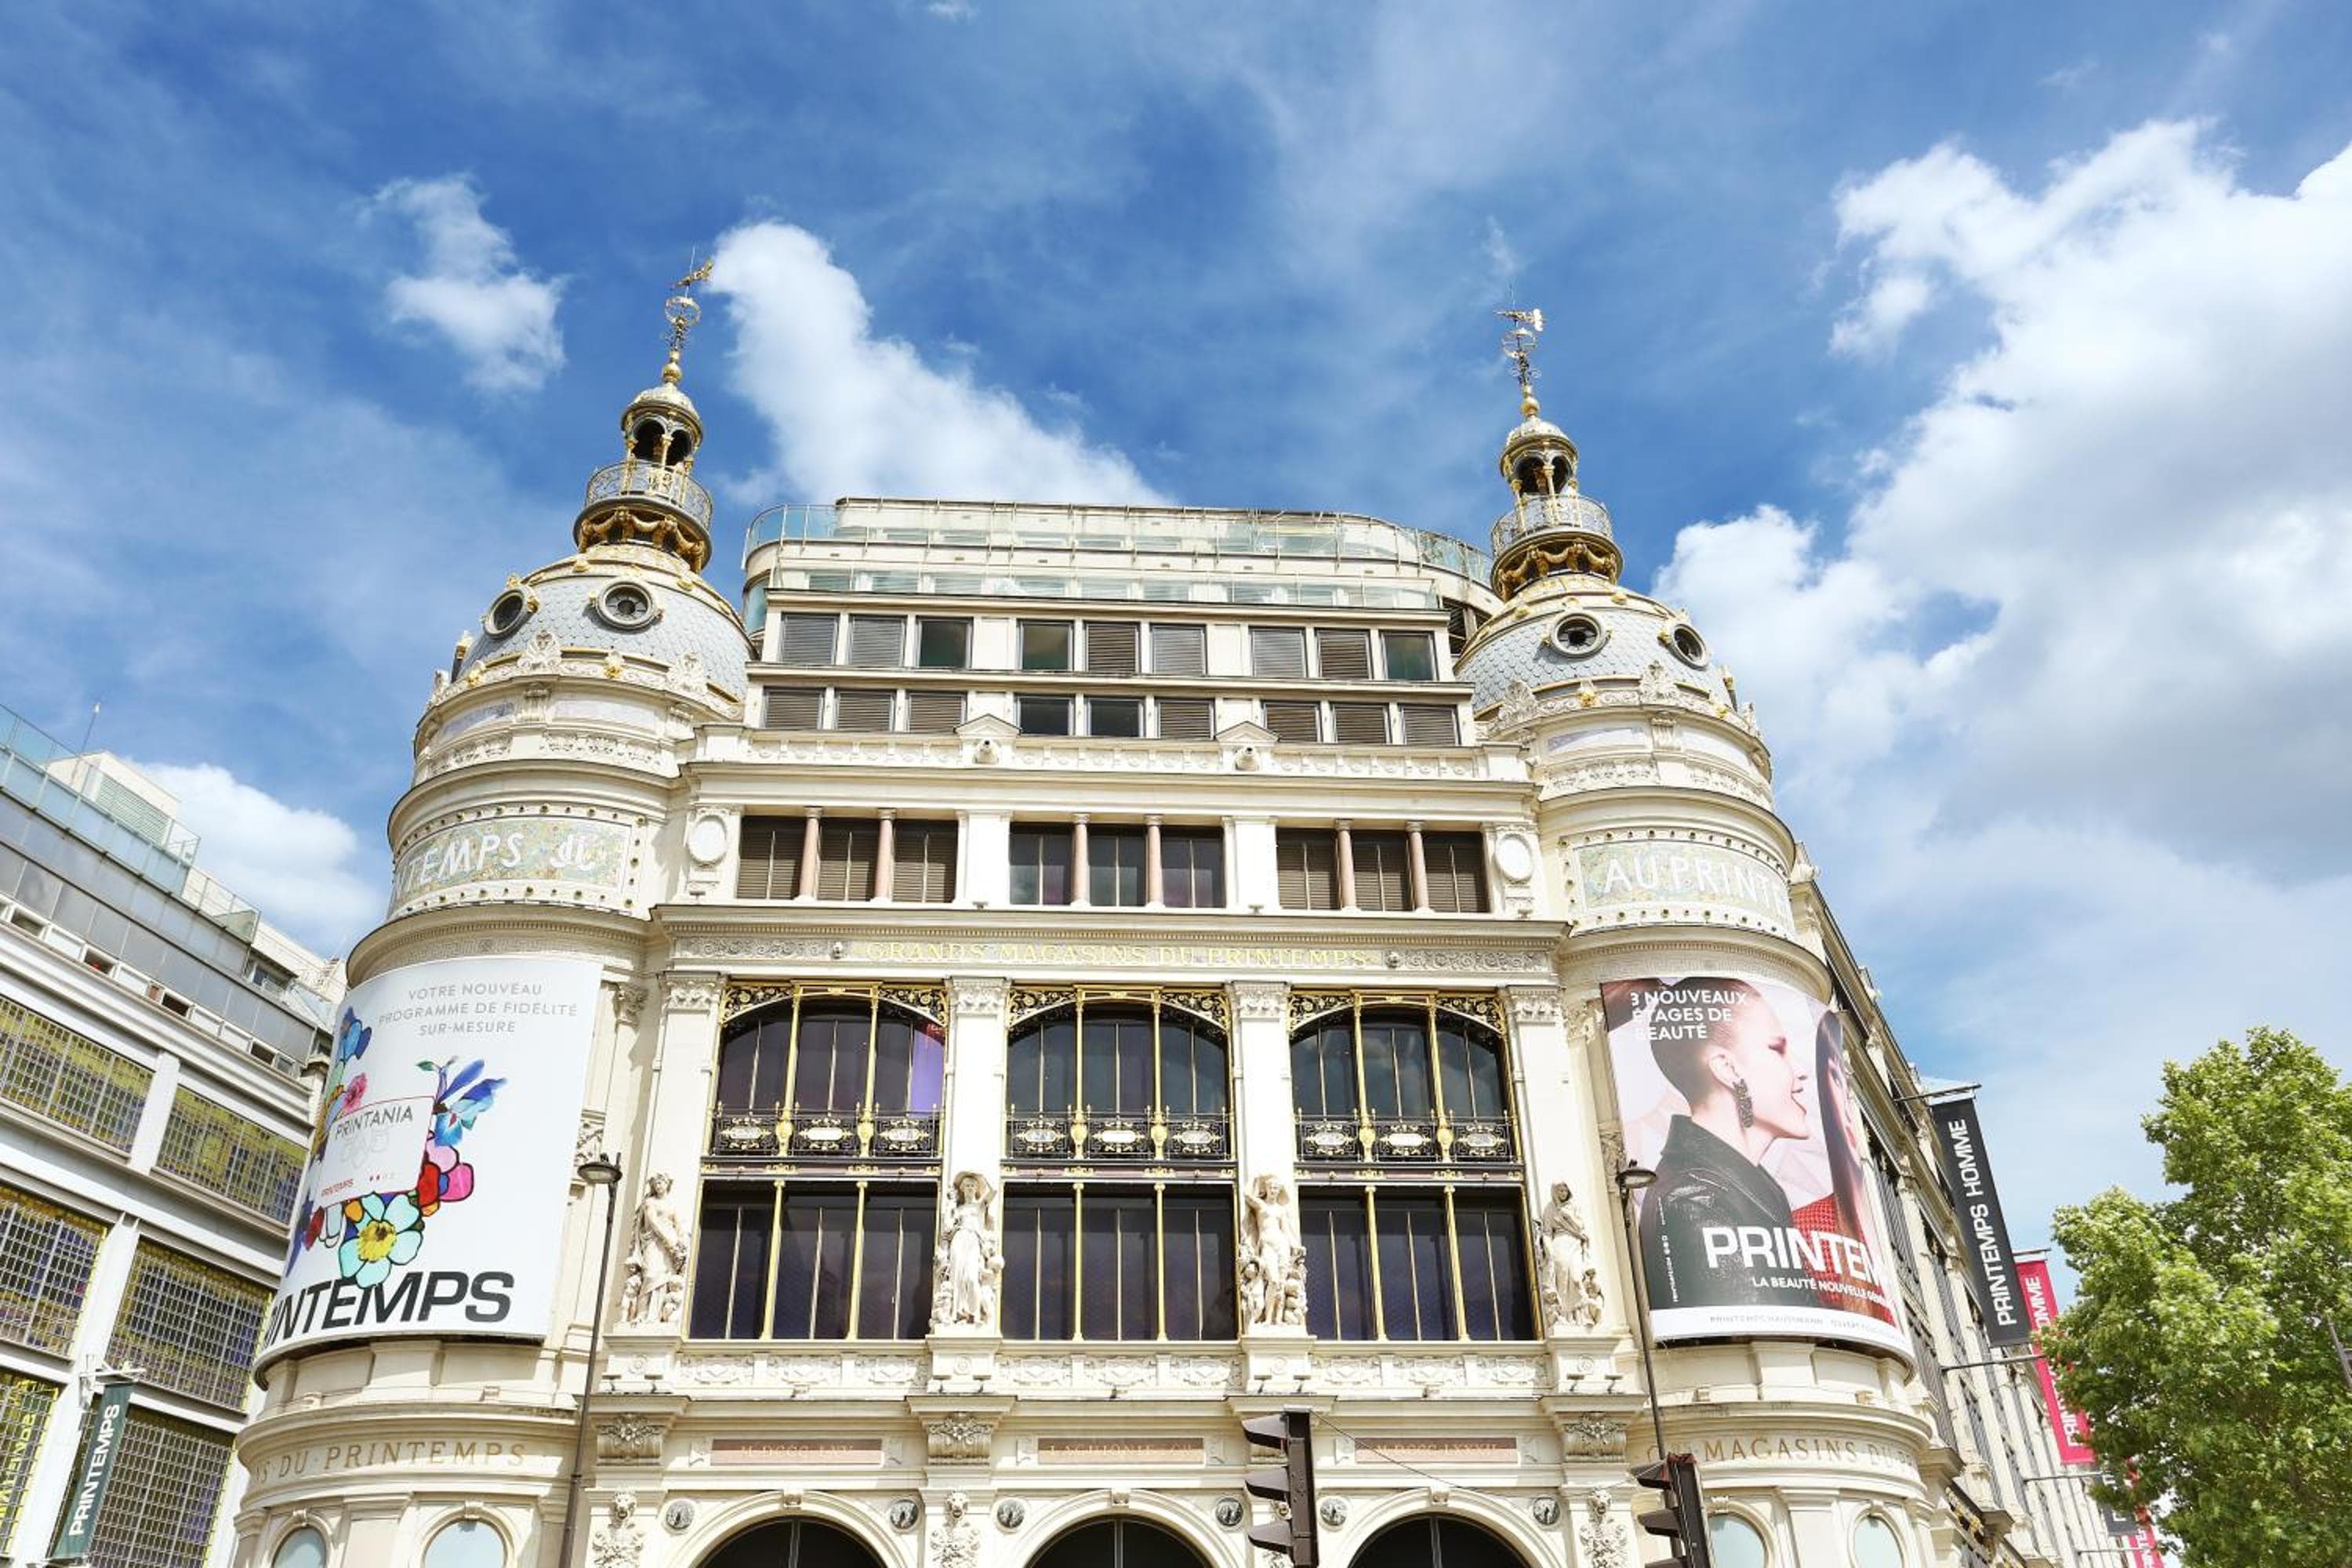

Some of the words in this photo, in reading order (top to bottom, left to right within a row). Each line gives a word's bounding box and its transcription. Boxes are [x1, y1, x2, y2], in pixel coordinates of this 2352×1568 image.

[1605, 854, 1657, 892] AU
[866, 942, 985, 959] GRANDS
[1160, 948, 1194, 964] DU
[1208, 949, 1367, 968] PRINTEMPS
[408, 985, 456, 1000] VOTRE
[462, 982, 543, 996] NOUVEAU
[1630, 992, 1639, 1006] 3
[1644, 989, 1748, 1004] NOUVEAUX
[378, 1003, 469, 1025] PROGRAMME
[475, 1001, 497, 1014] DE
[1708, 1007, 1732, 1022] DE
[419, 1021, 515, 1036] SUR-MESURE
[335, 1105, 414, 1140] PRINTANIA
[1948, 1119, 1984, 1197] HOMME
[1970, 1203, 2017, 1327] PRINTEMPS
[1751, 1277, 1769, 1288] LA
[1771, 1274, 1817, 1290] BEAUTÉ
[278, 1454, 309, 1478] DU
[323, 1441, 528, 1470] PRINTEMPS
[1704, 1437, 1858, 1464] MAGASINS
[68, 1404, 120, 1537] PRINTEMPS
